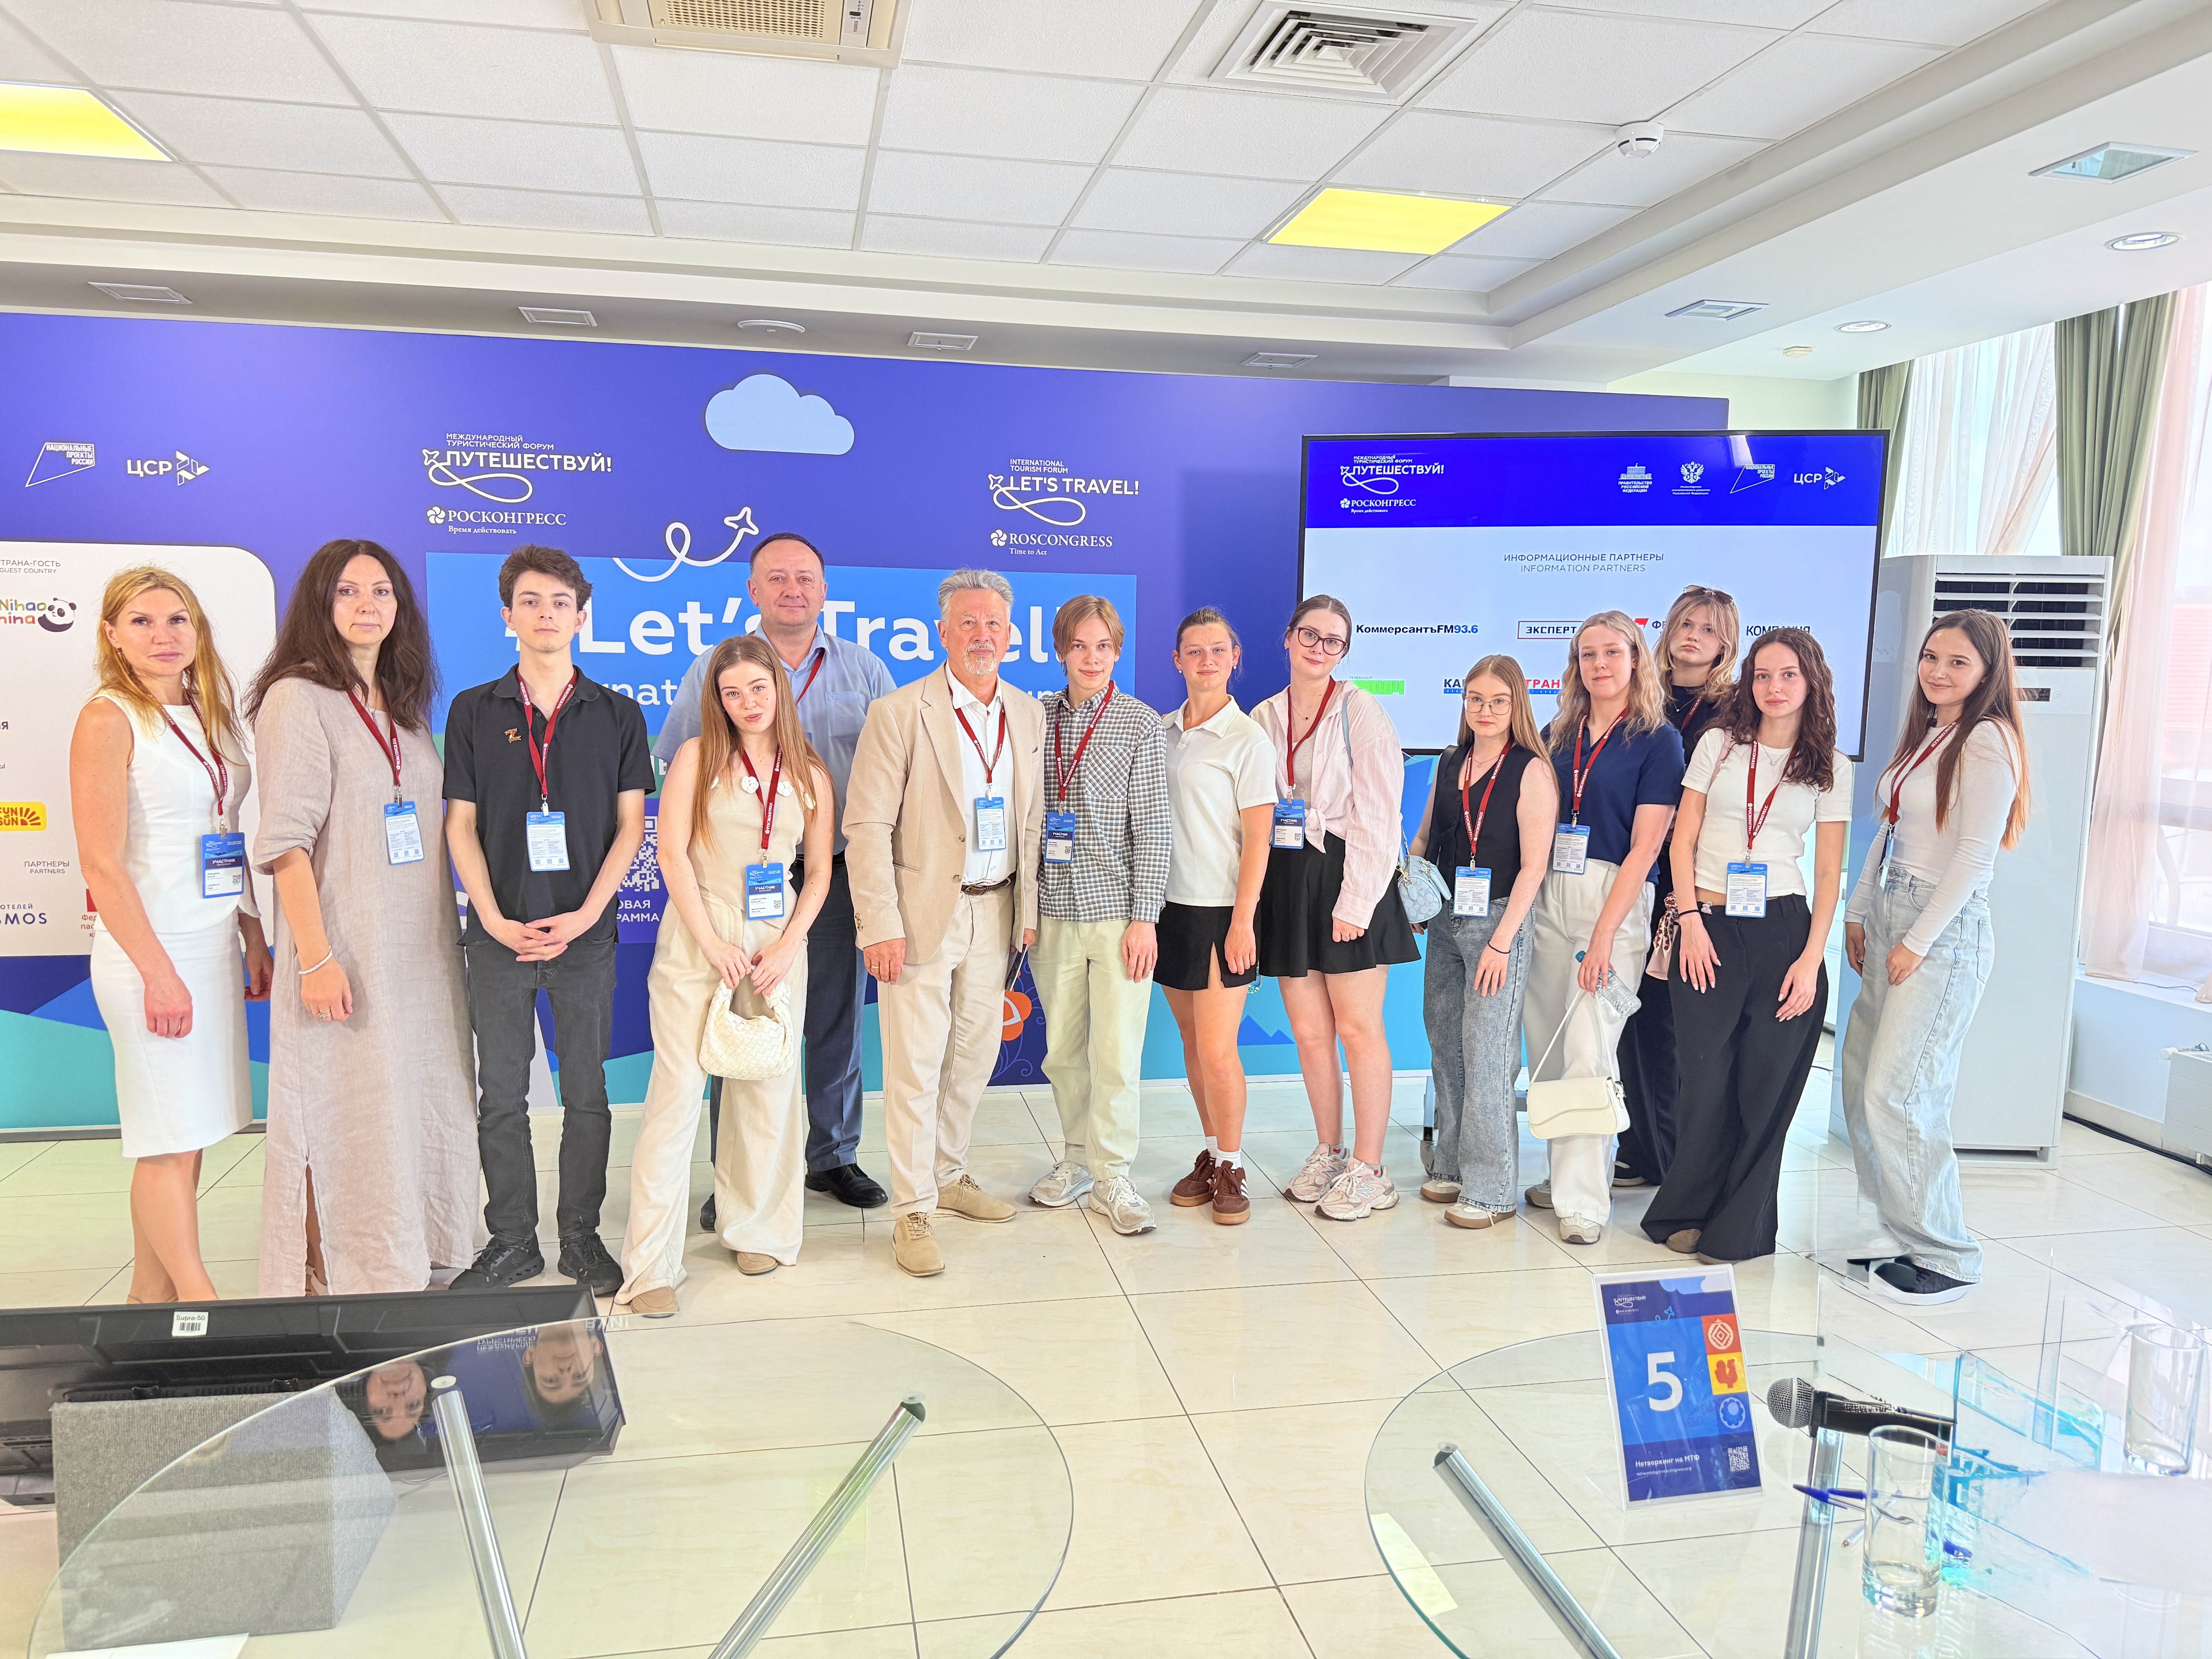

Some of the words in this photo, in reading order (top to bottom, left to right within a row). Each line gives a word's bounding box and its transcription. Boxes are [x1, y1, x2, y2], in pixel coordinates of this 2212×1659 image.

[447, 433, 523, 442] МЕЖДУНАРОДНЫЙ
[447, 440, 520, 448] ТУРИСТИЧЕСКИЙ
[447, 450, 612, 472] ПУТЕШЕСТВУЙ!
[1010, 459, 1064, 467] INTERNATIONAL
[127, 460, 172, 477] ЦСР
[1352, 462, 1444, 475] ПУТЕШЕСТВУЙ!
[1009, 476, 1058, 492] LET'S
[1061, 478, 1139, 495] TRAVEL!
[1794, 473, 1822, 485] ЦСР
[448, 510, 566, 525] РОСКОНГРЕСС
[448, 526, 471, 534] Время
[1009, 533, 1113, 547] ROSCONGRESS
[1504, 554, 1606, 562] ИНФОРМАЦИОННЫЕ
[505, 592, 762, 656] Let'
[1065, 759, 1077, 783] ROSCONGRESS
[1647, 1352, 1683, 1411] 5
[1635, 1458, 1673, 1468] Нетворкинг
